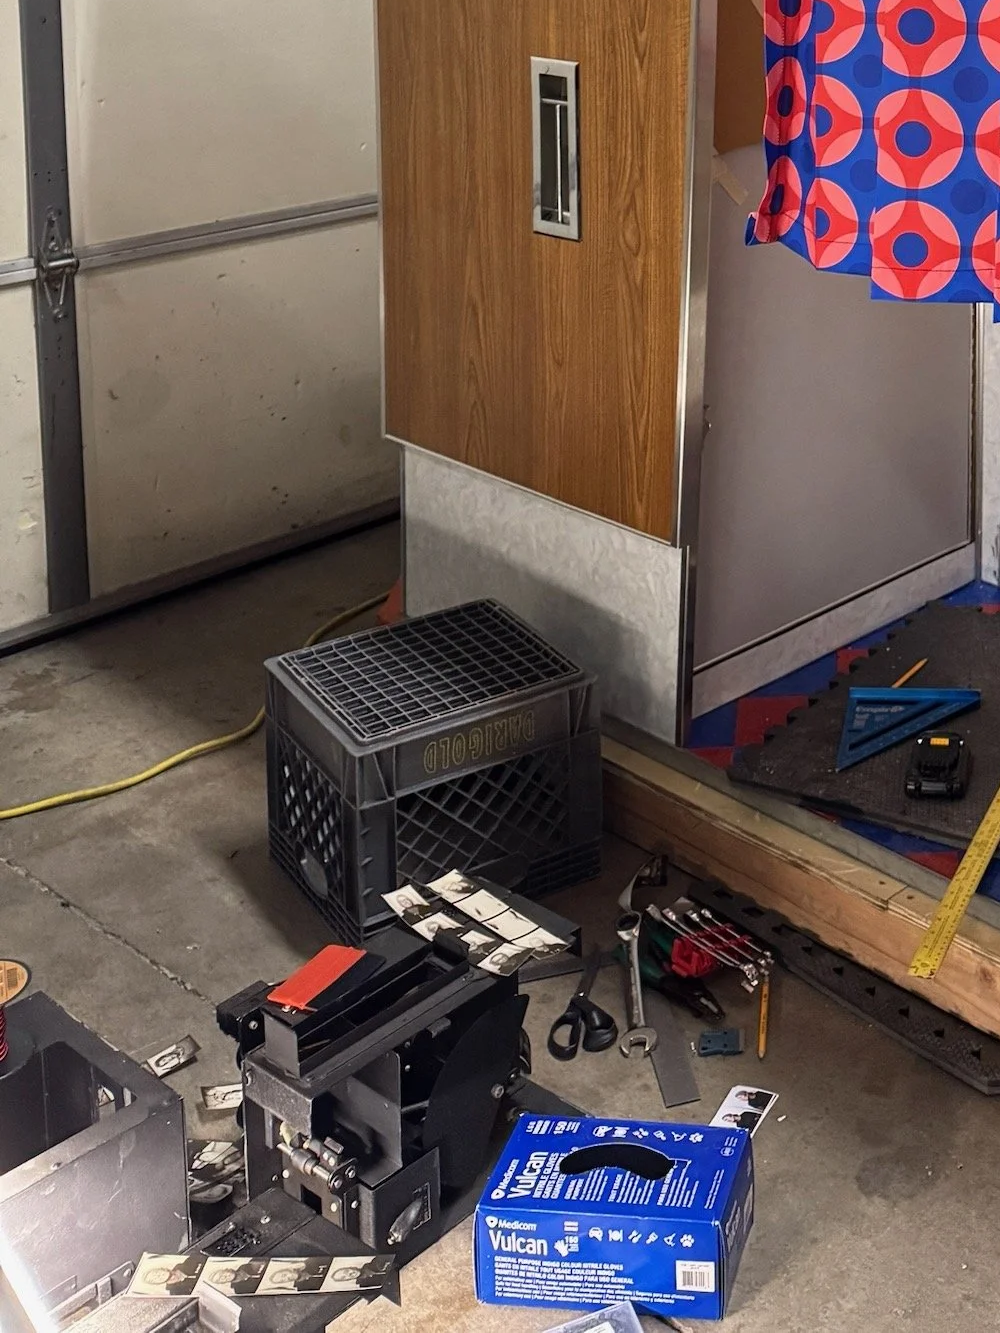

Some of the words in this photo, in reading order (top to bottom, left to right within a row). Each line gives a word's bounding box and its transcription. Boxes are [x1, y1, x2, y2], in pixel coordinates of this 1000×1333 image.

[424, 710, 535, 774] DARIGOLD
[507, 1151, 549, 1199] Vulcan
[489, 1230, 548, 1256] Vulcan
[498, 1218, 537, 1231] Medicom
